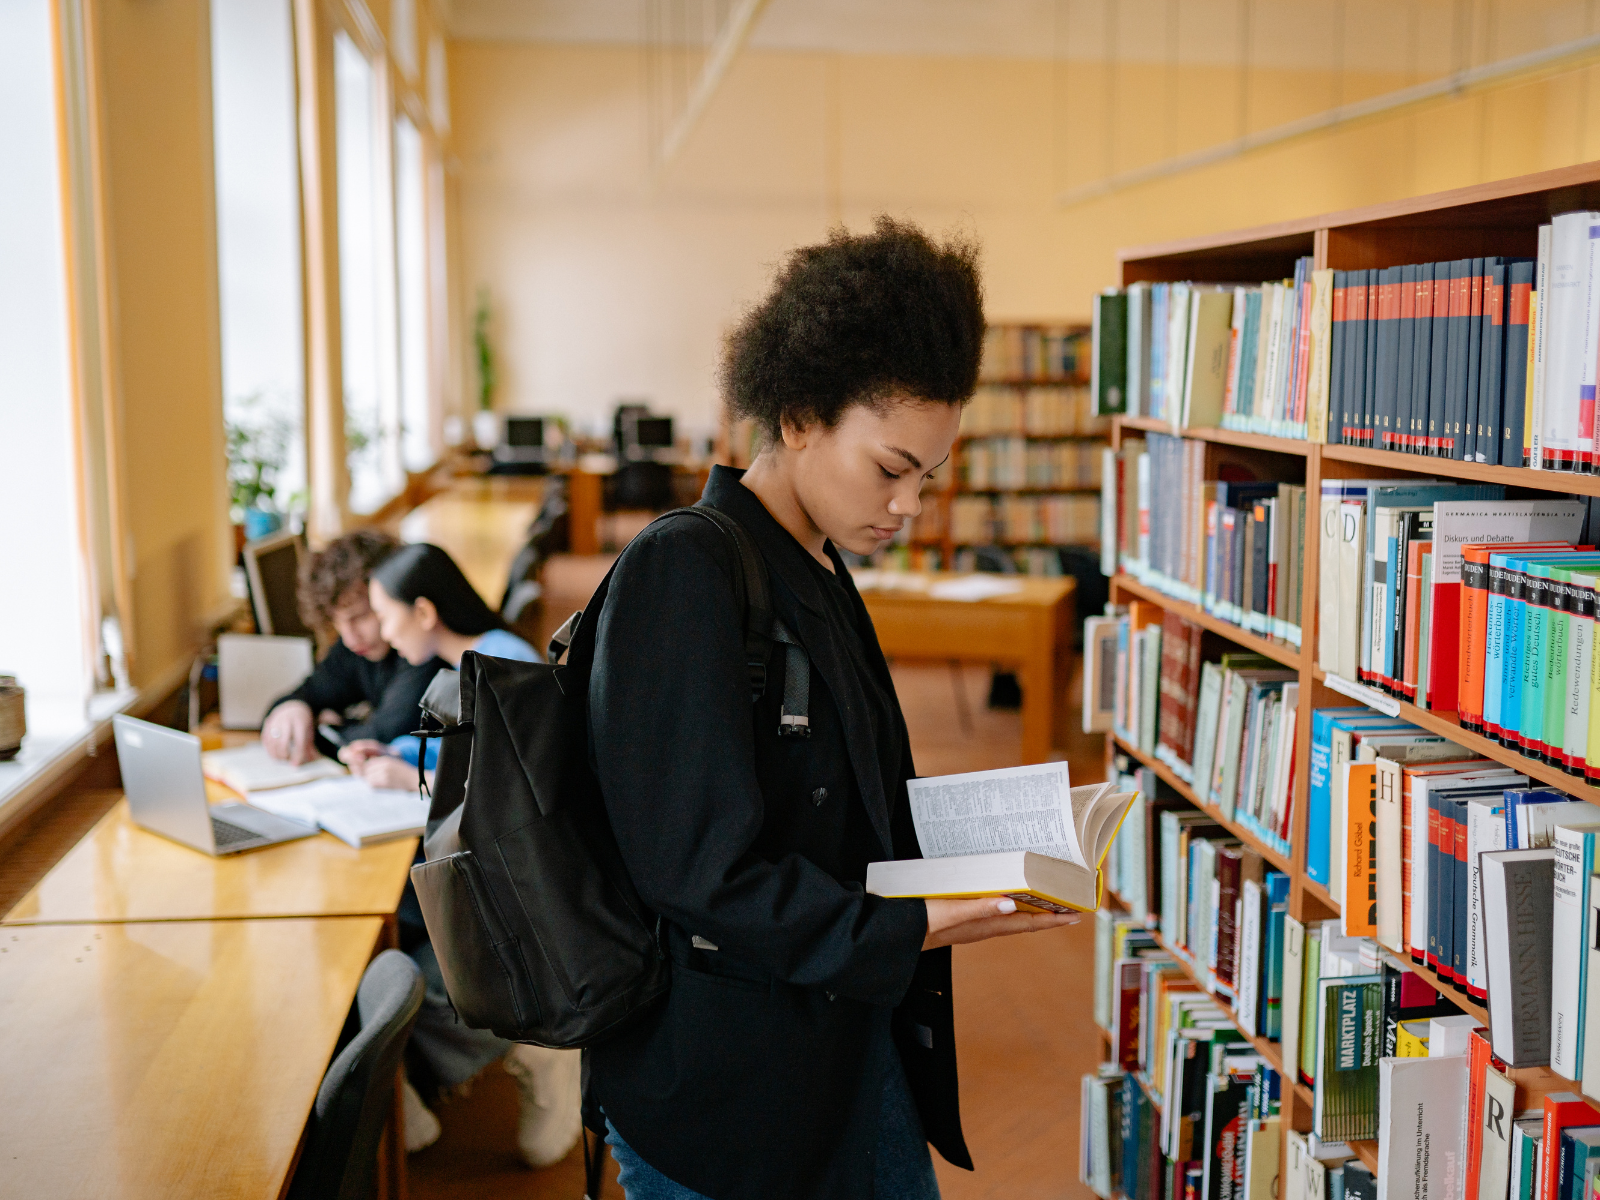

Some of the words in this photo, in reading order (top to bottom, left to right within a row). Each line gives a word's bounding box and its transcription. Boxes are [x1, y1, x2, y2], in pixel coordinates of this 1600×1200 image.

[1325, 509, 1337, 539] C
[1343, 513, 1356, 543] D
[1444, 535, 1469, 543] Diskurs
[1470, 535, 1485, 543] und
[1486, 534, 1515, 543] Debatte
[1464, 565, 1484, 574] DUDEN
[1526, 577, 1549, 591] DUDEN
[1511, 586, 1515, 594] 8
[1531, 592, 1536, 600] 9
[1549, 583, 1572, 595] DUDEN
[1554, 596, 1561, 606] 10
[1571, 588, 1596, 601] DUDEN
[1577, 602, 1584, 611] 11
[1464, 595, 1474, 684] Fremdwörterbuch
[1493, 602, 1503, 660] wörterbuch
[1511, 606, 1520, 643] Wörter
[1532, 613, 1541, 657] Deutsch
[1523, 634, 1532, 683] Richtiges
[1555, 620, 1564, 676] wörterbuch
[1508, 646, 1518, 699] verwandte
[1531, 659, 1539, 688] gutes
[1571, 624, 1584, 715] Redewendungen
[1336, 741, 1345, 765] F
[1379, 769, 1396, 803] H
[1353, 822, 1363, 847] Göbel
[1353, 848, 1363, 878] Richard
[1472, 865, 1480, 910] Deutsche
[1513, 872, 1536, 936] HESSE
[1288, 926, 1298, 957] L
[1470, 911, 1479, 968] Grammatik
[1517, 943, 1541, 1055] HERMANN
[1340, 990, 1357, 1068] MARKTPLATZ
[1363, 1009, 1374, 1036] Sprache
[1361, 1036, 1372, 1067] Deutsche
[1416, 1103, 1424, 1137] Unterricht
[1485, 1092, 1506, 1142] R
[1415, 1137, 1422, 1147] im
[1422, 1133, 1430, 1182] Fremdsprache
[1304, 1162, 1322, 1198] W
